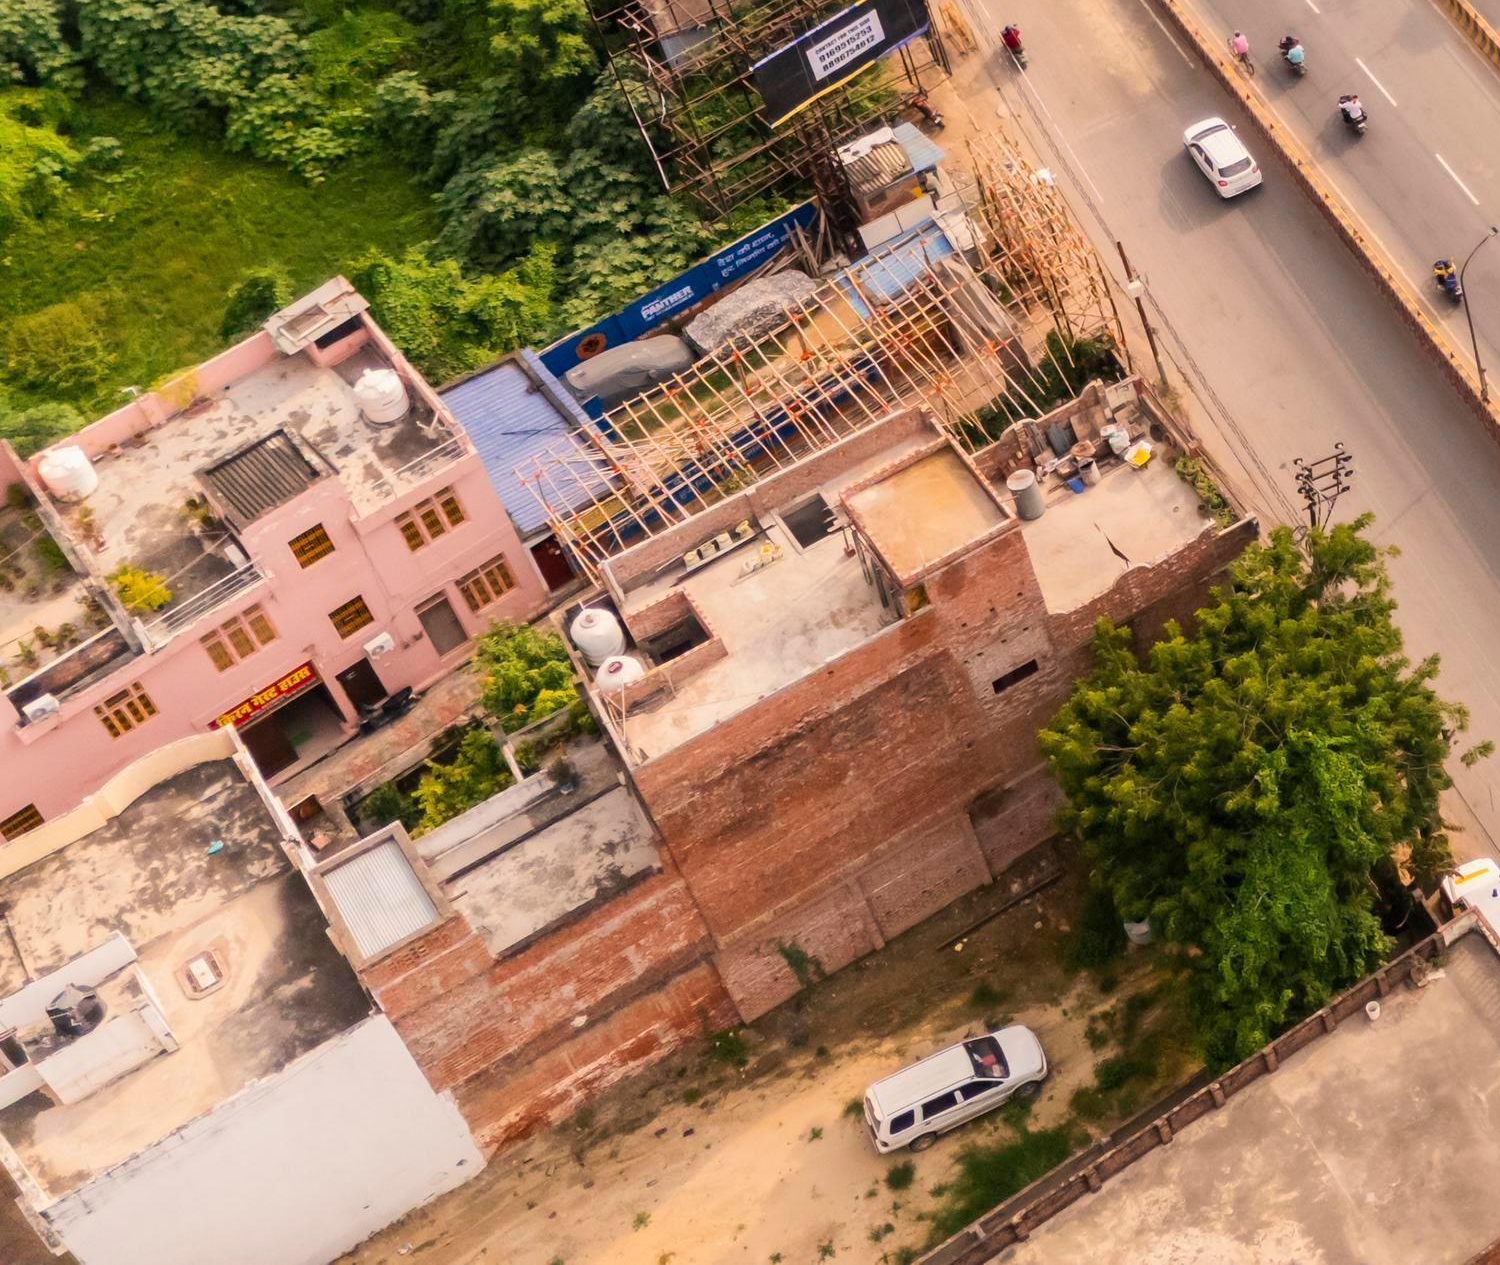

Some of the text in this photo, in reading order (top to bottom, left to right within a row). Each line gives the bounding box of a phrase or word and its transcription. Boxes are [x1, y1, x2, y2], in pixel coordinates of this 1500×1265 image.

[641, 285, 693, 320] PANTHER
[251, 685, 279, 707] गेस्ट
[278, 665, 312, 692] हाउस
